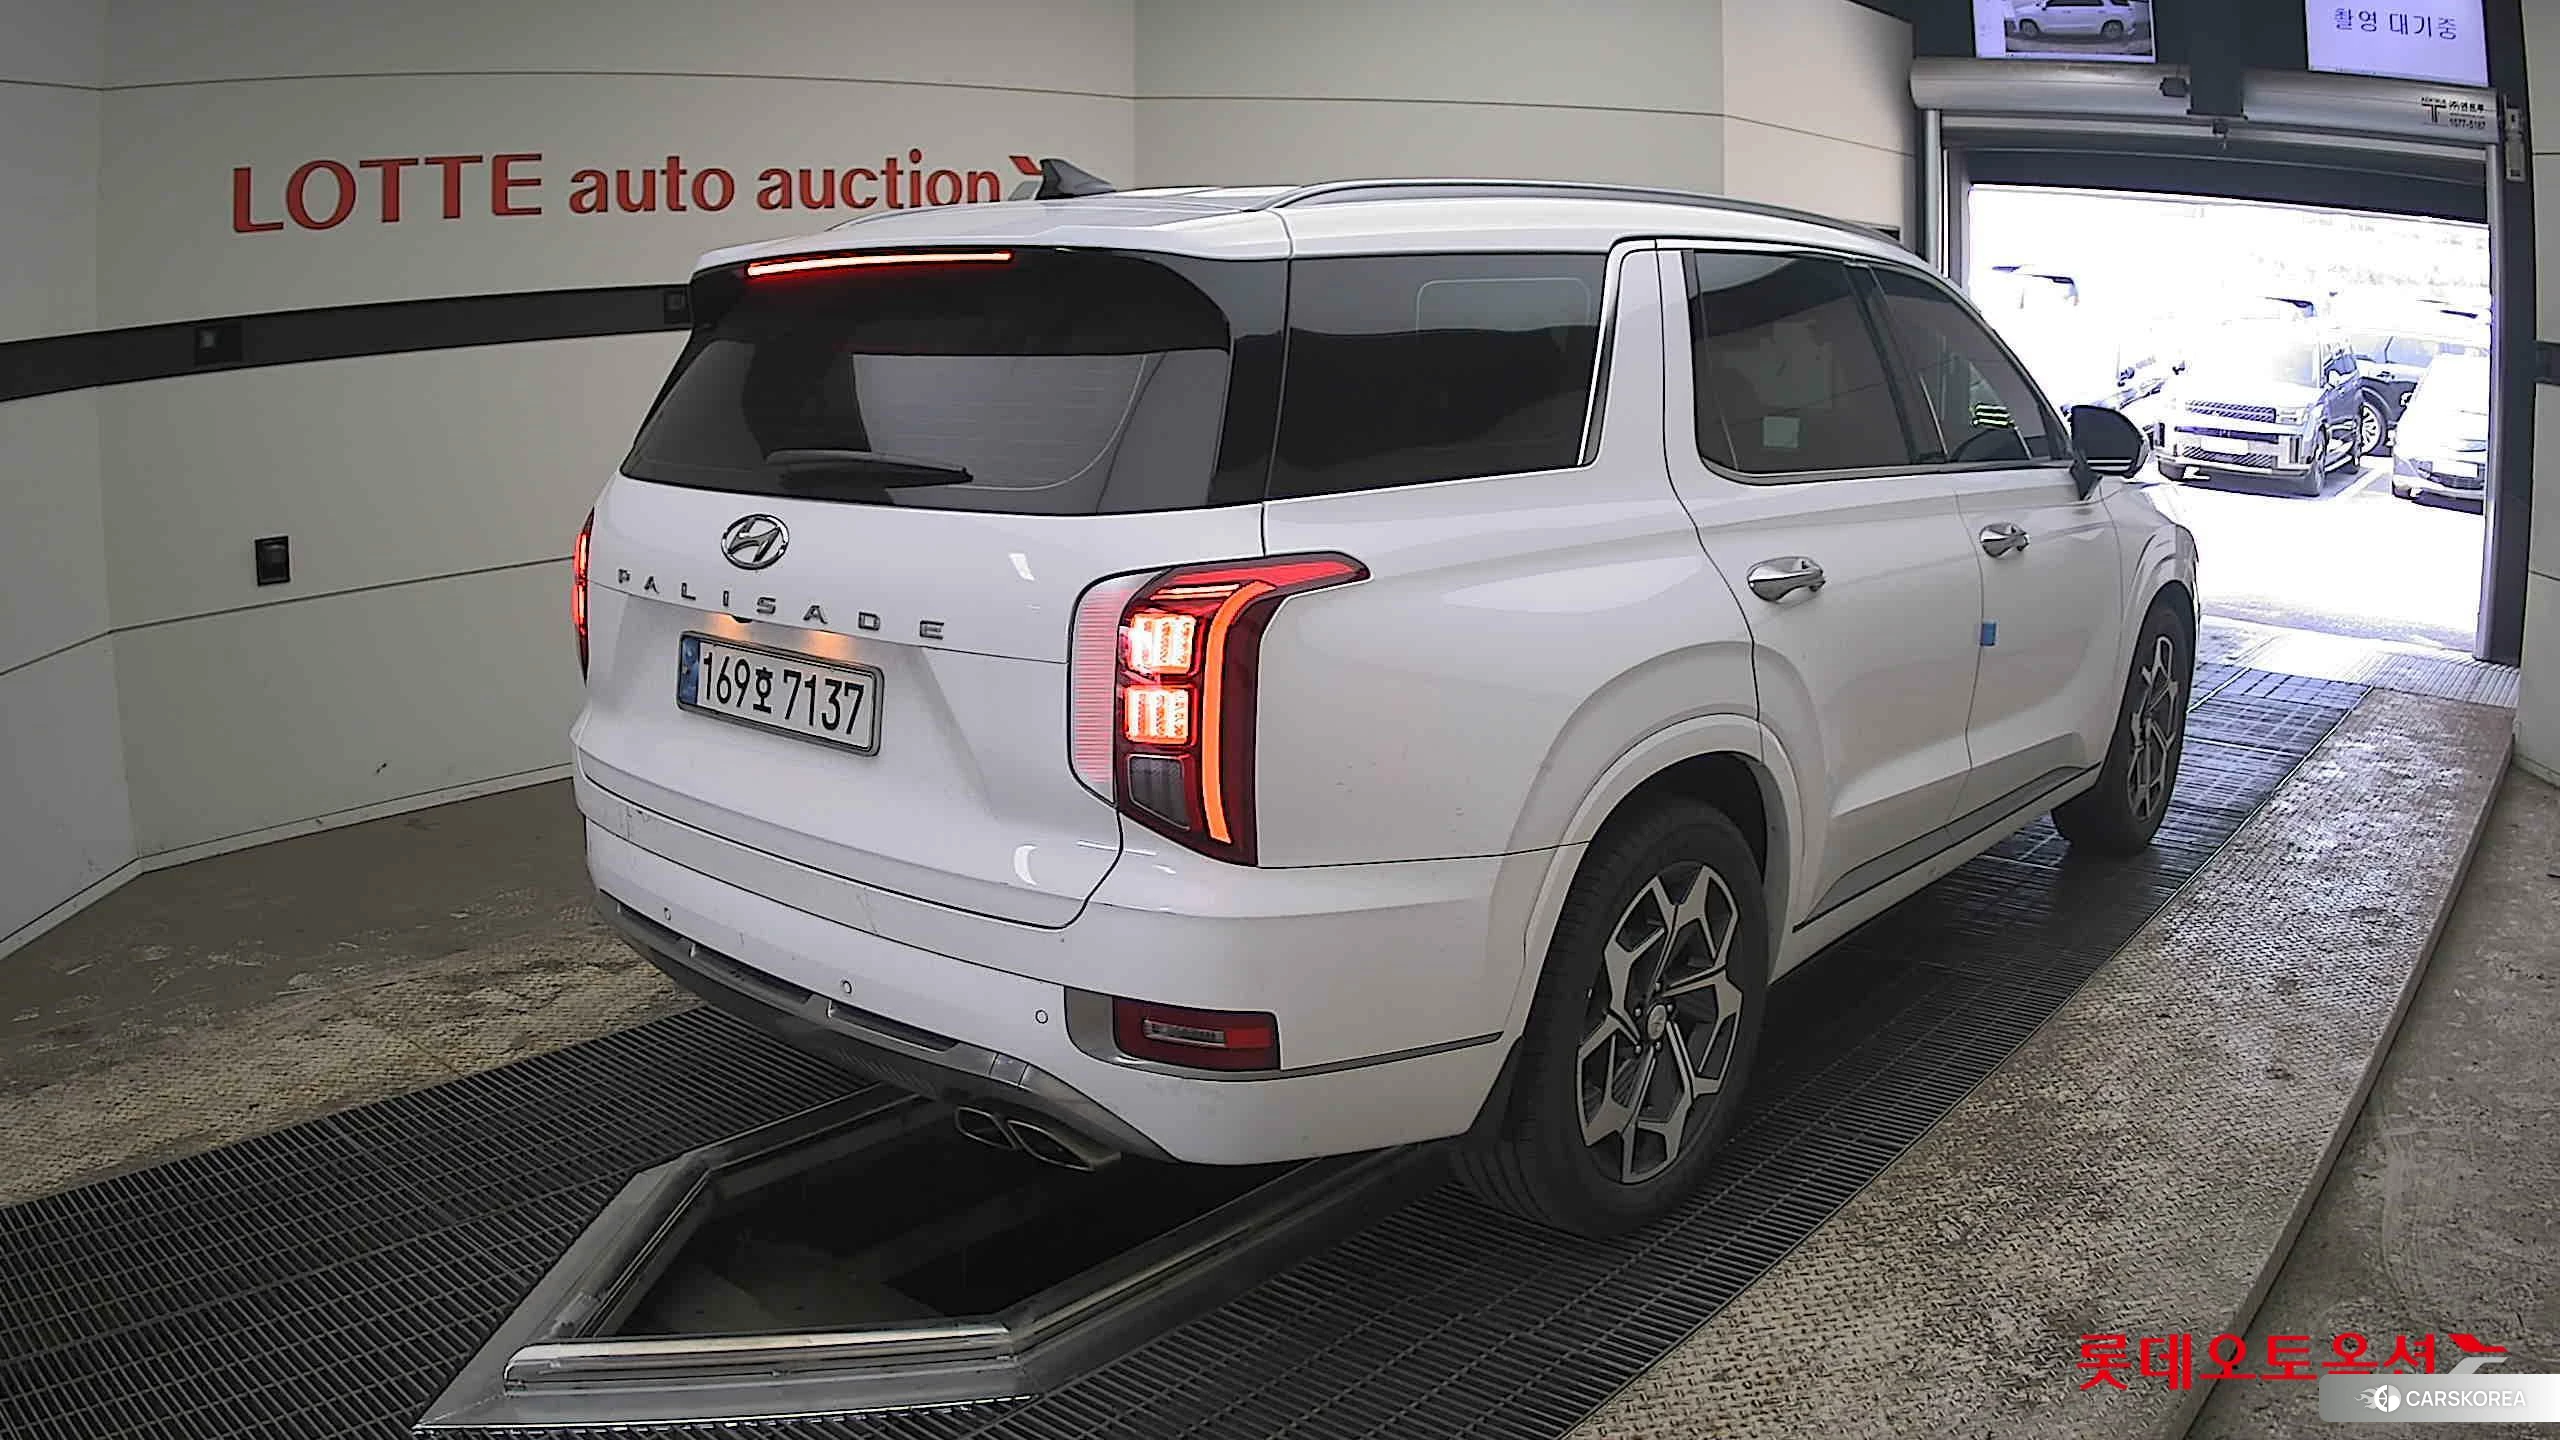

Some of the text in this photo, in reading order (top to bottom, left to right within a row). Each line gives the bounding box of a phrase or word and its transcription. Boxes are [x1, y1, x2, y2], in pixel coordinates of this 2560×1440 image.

[2334, 8, 2457, 40] 촬영 대기중
[232, 148, 1001, 233] LOTTE auto auction
[617, 568, 945, 640] PALISADE
[703, 652, 865, 735] 169호 7137
